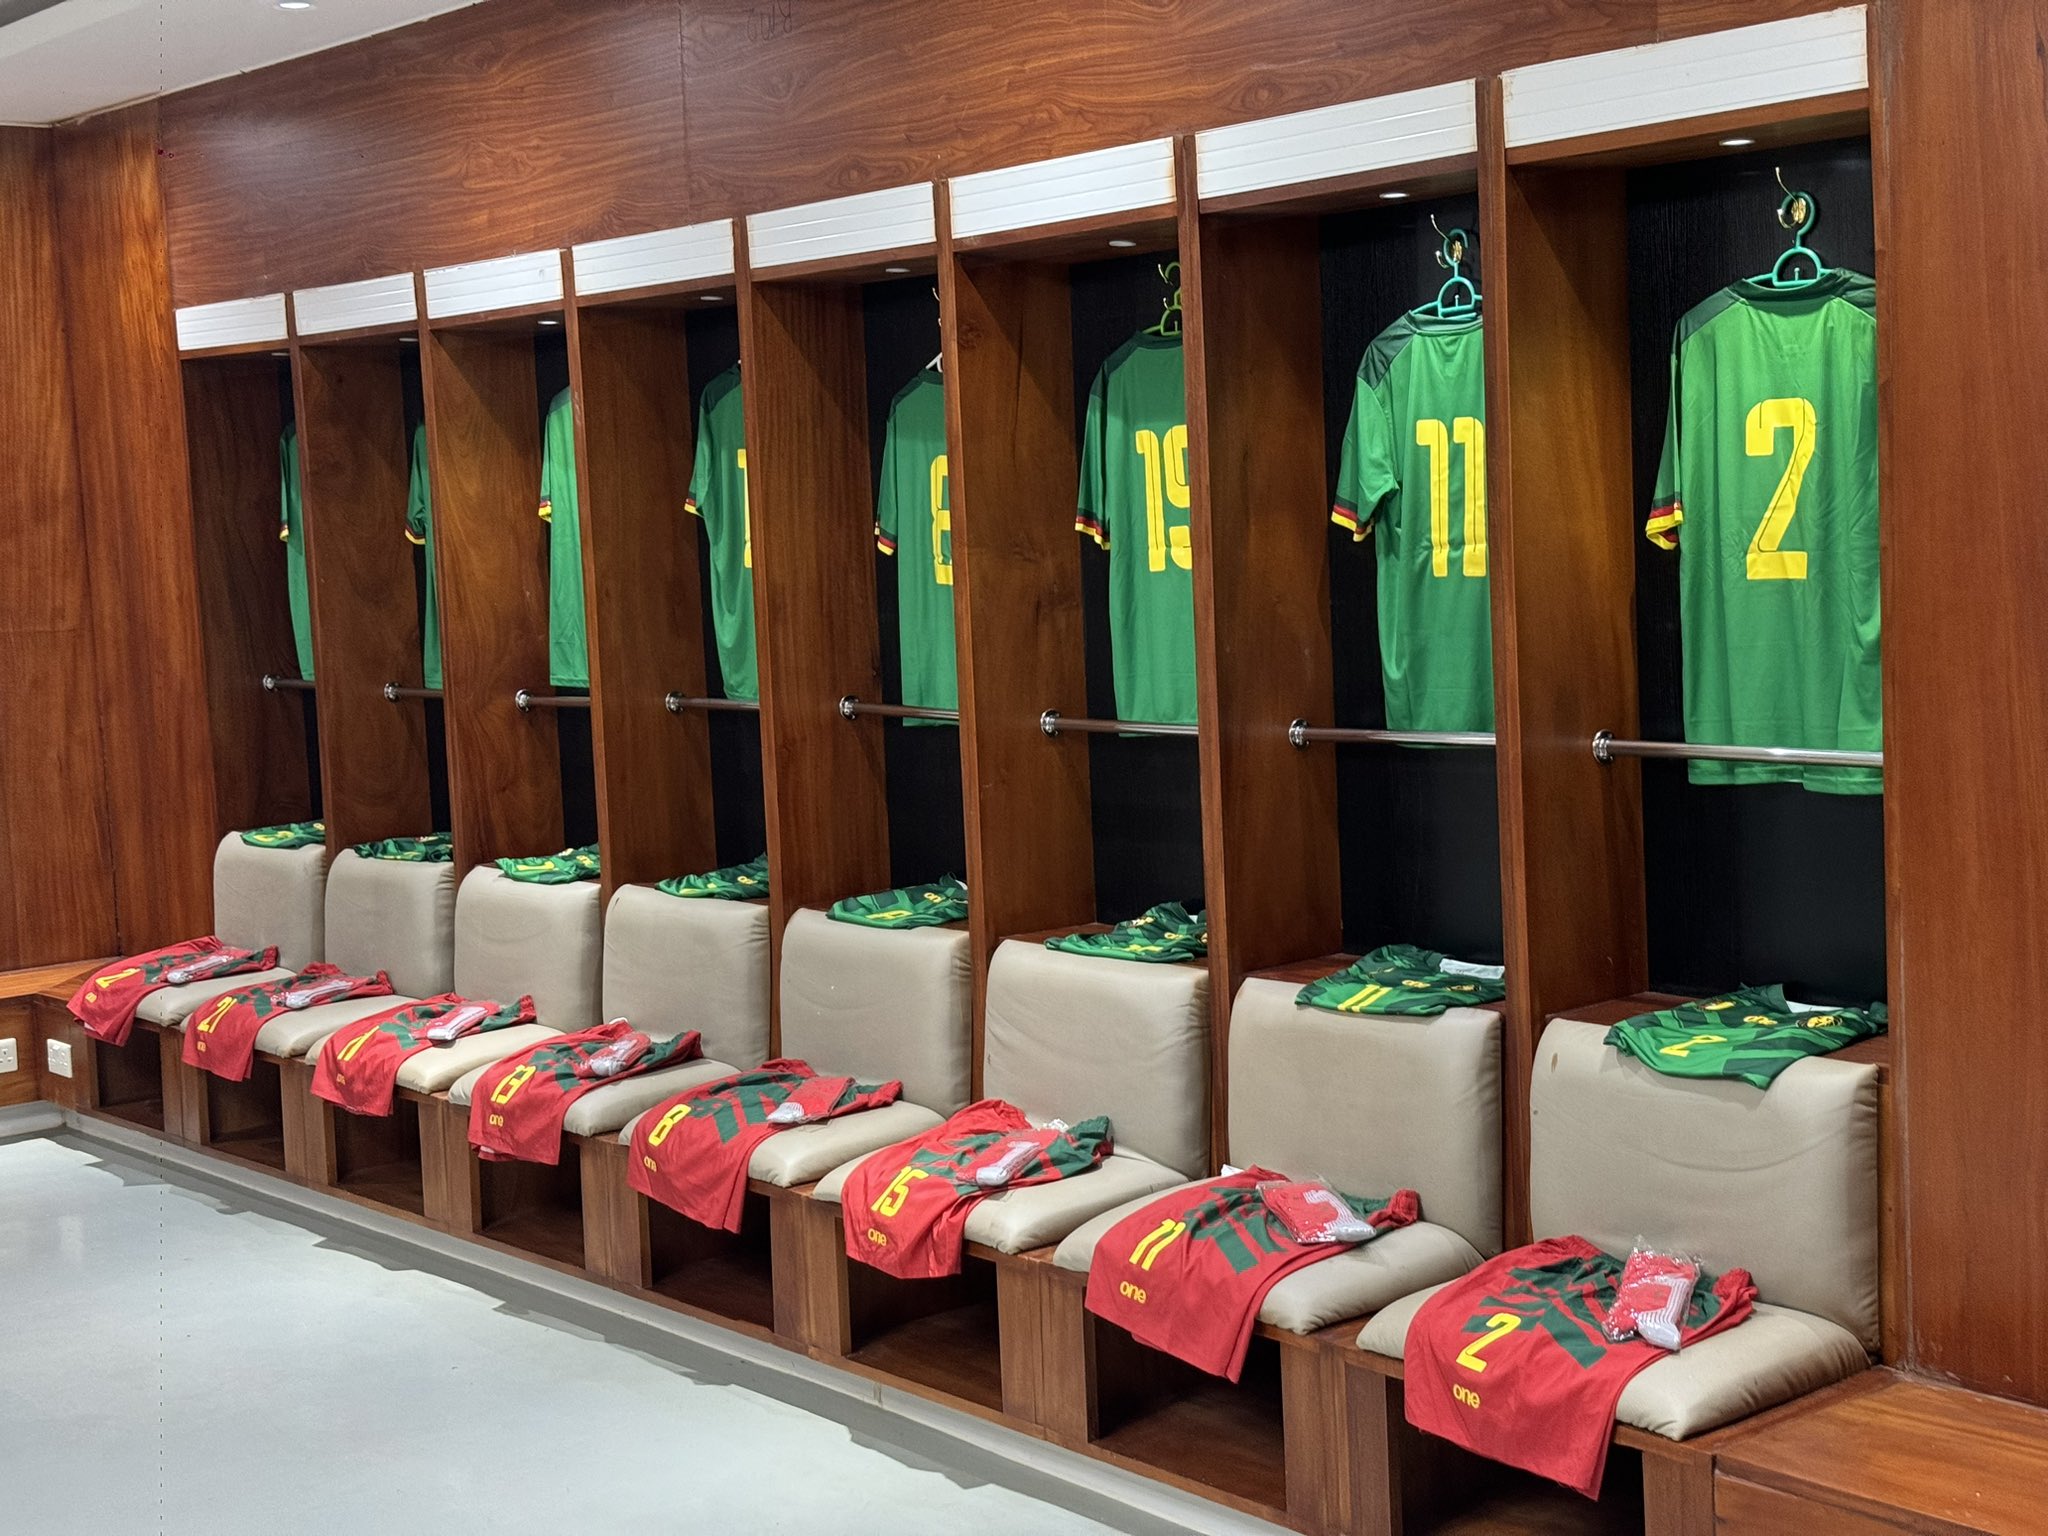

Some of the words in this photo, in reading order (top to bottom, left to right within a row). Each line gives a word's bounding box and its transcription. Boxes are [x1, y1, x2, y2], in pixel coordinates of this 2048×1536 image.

[1416, 417, 1488, 577] 11
[1746, 397, 1817, 580] 2
[1660, 1034, 1727, 1057] 2
[870, 1165, 929, 1217] 15
[867, 1227, 887, 1247] one
[1128, 1218, 1187, 1271] 11
[1119, 1280, 1147, 1304] one
[1455, 1312, 1521, 1373] 2
[1452, 1383, 1481, 1409] one
